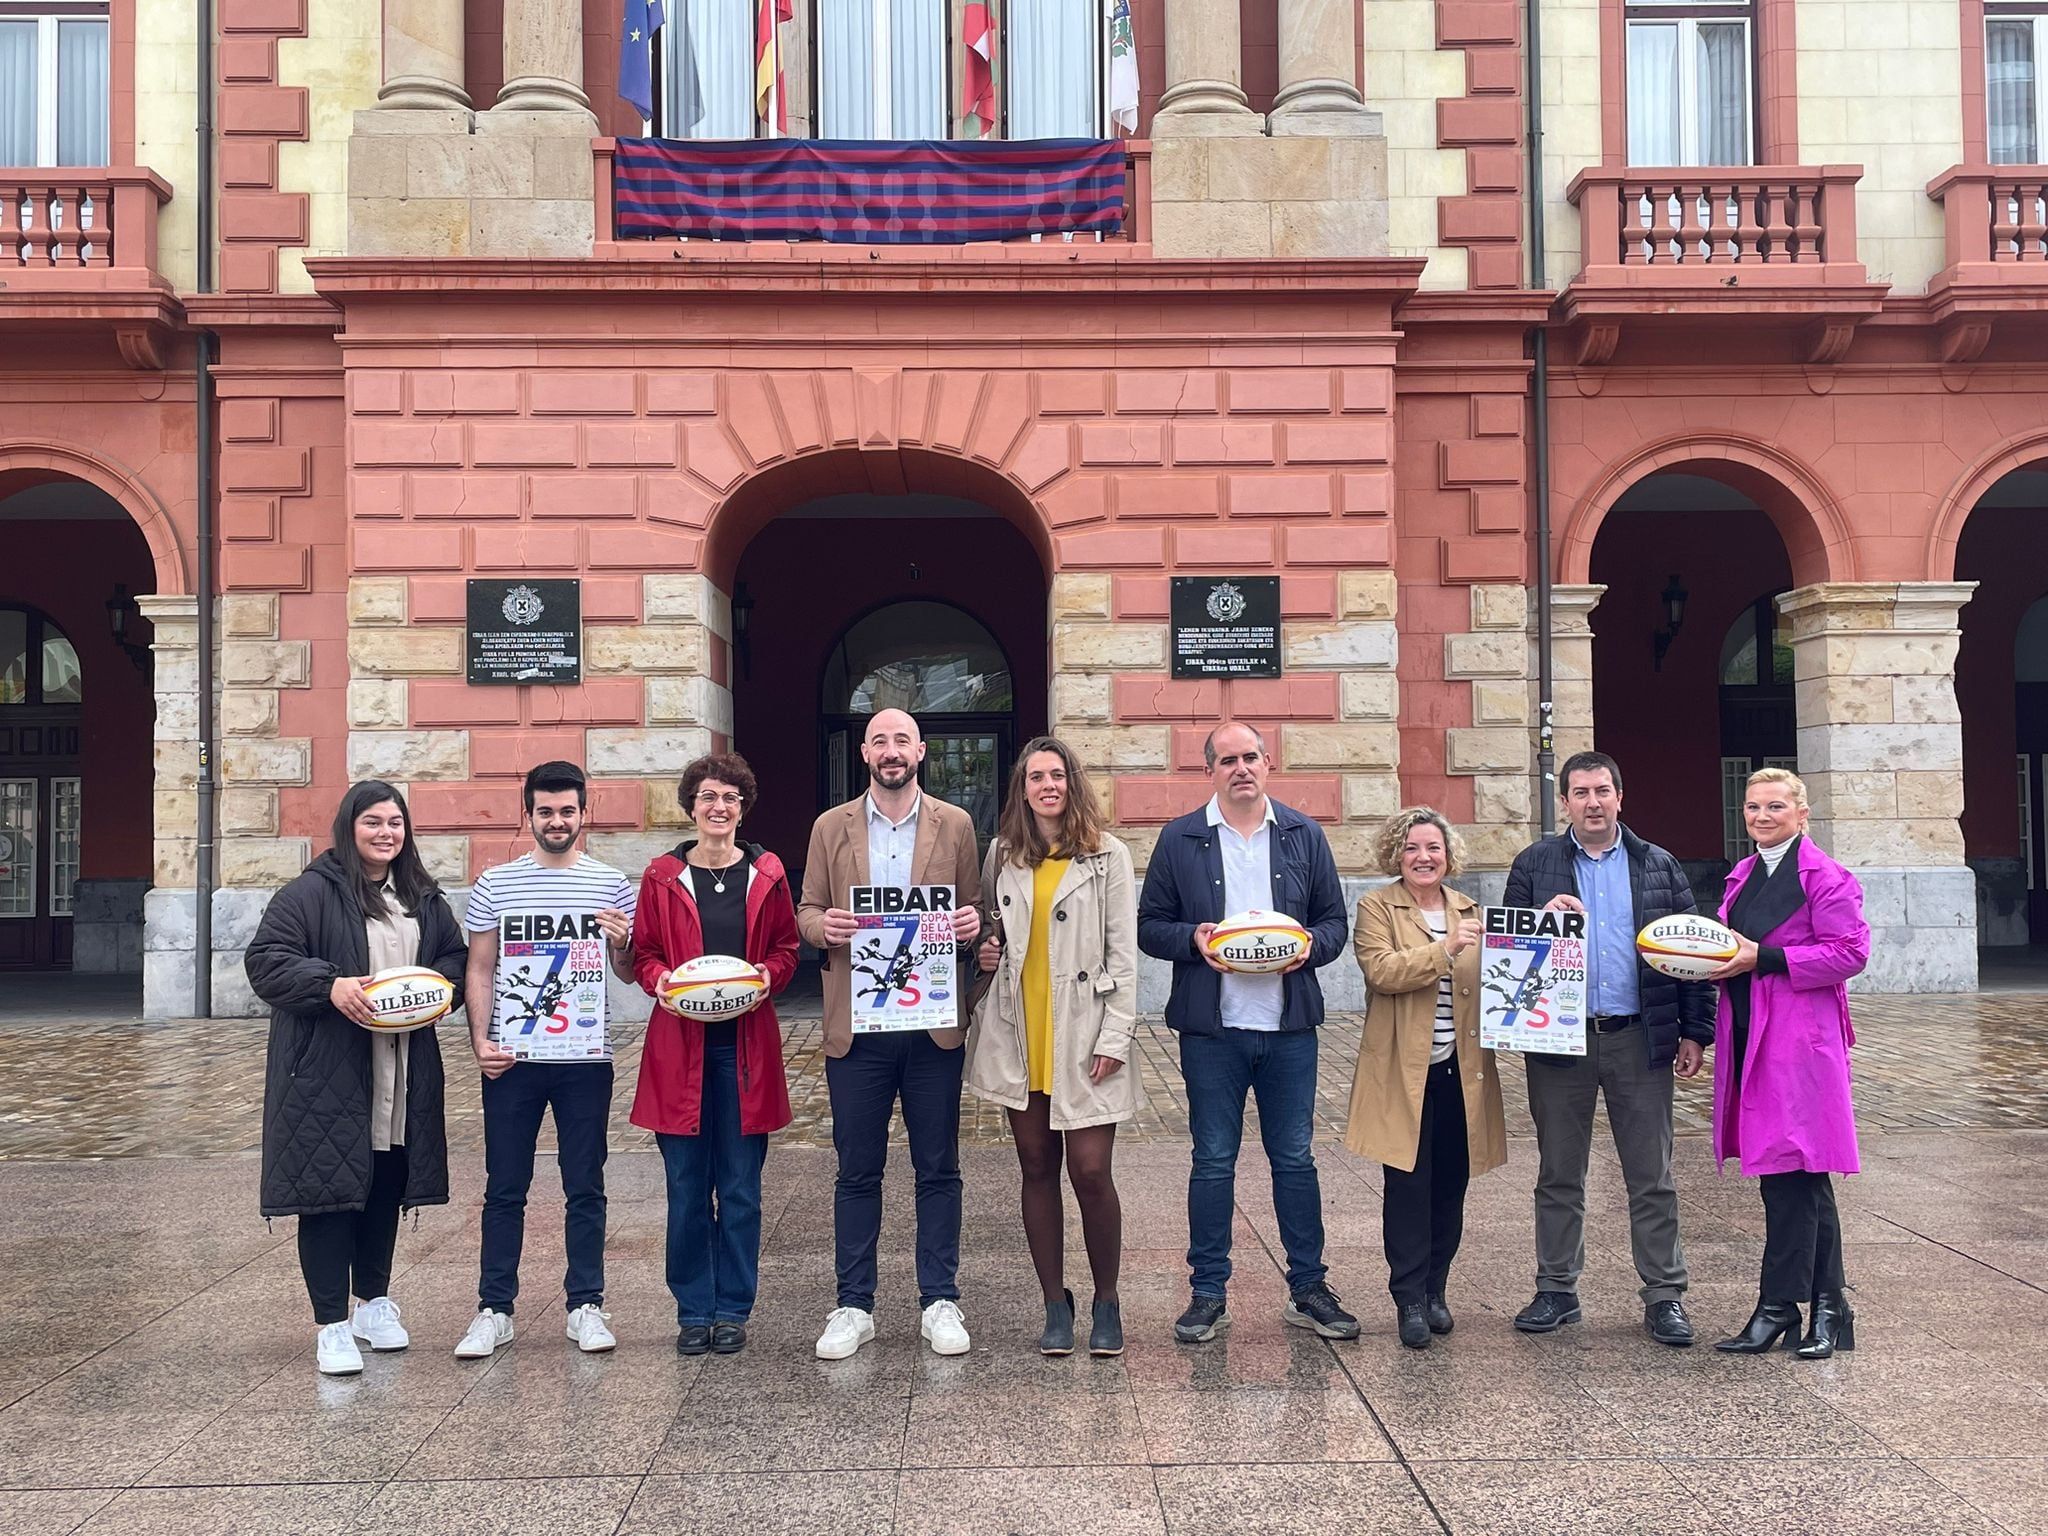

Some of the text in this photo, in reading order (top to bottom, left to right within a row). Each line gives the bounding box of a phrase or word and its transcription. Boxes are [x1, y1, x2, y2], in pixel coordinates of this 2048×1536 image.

[854, 887, 952, 914] EIBAR
[856, 916, 882, 928] GPS
[921, 913, 949, 922] COPA
[1486, 908, 1585, 939] EIBAR
[504, 914, 602, 940] EIBAR
[921, 923, 952, 932] DE LA
[921, 933, 953, 942] REINA
[1653, 925, 1731, 945] GILBERT
[571, 941, 599, 950] COPA
[1487, 936, 1514, 949] GPS
[1552, 939, 1580, 949] COPA
[505, 943, 533, 956] GPS
[571, 951, 602, 959] DE LA
[921, 943, 953, 955] 2023
[1223, 942, 1297, 960] GILBERT
[1552, 949, 1584, 959] DE LA
[571, 961, 602, 969] REINA
[1552, 959, 1584, 969] REINA
[571, 971, 603, 982] 2023
[1552, 968, 1584, 981] 2023
[680, 991, 756, 1011] GILBERT
